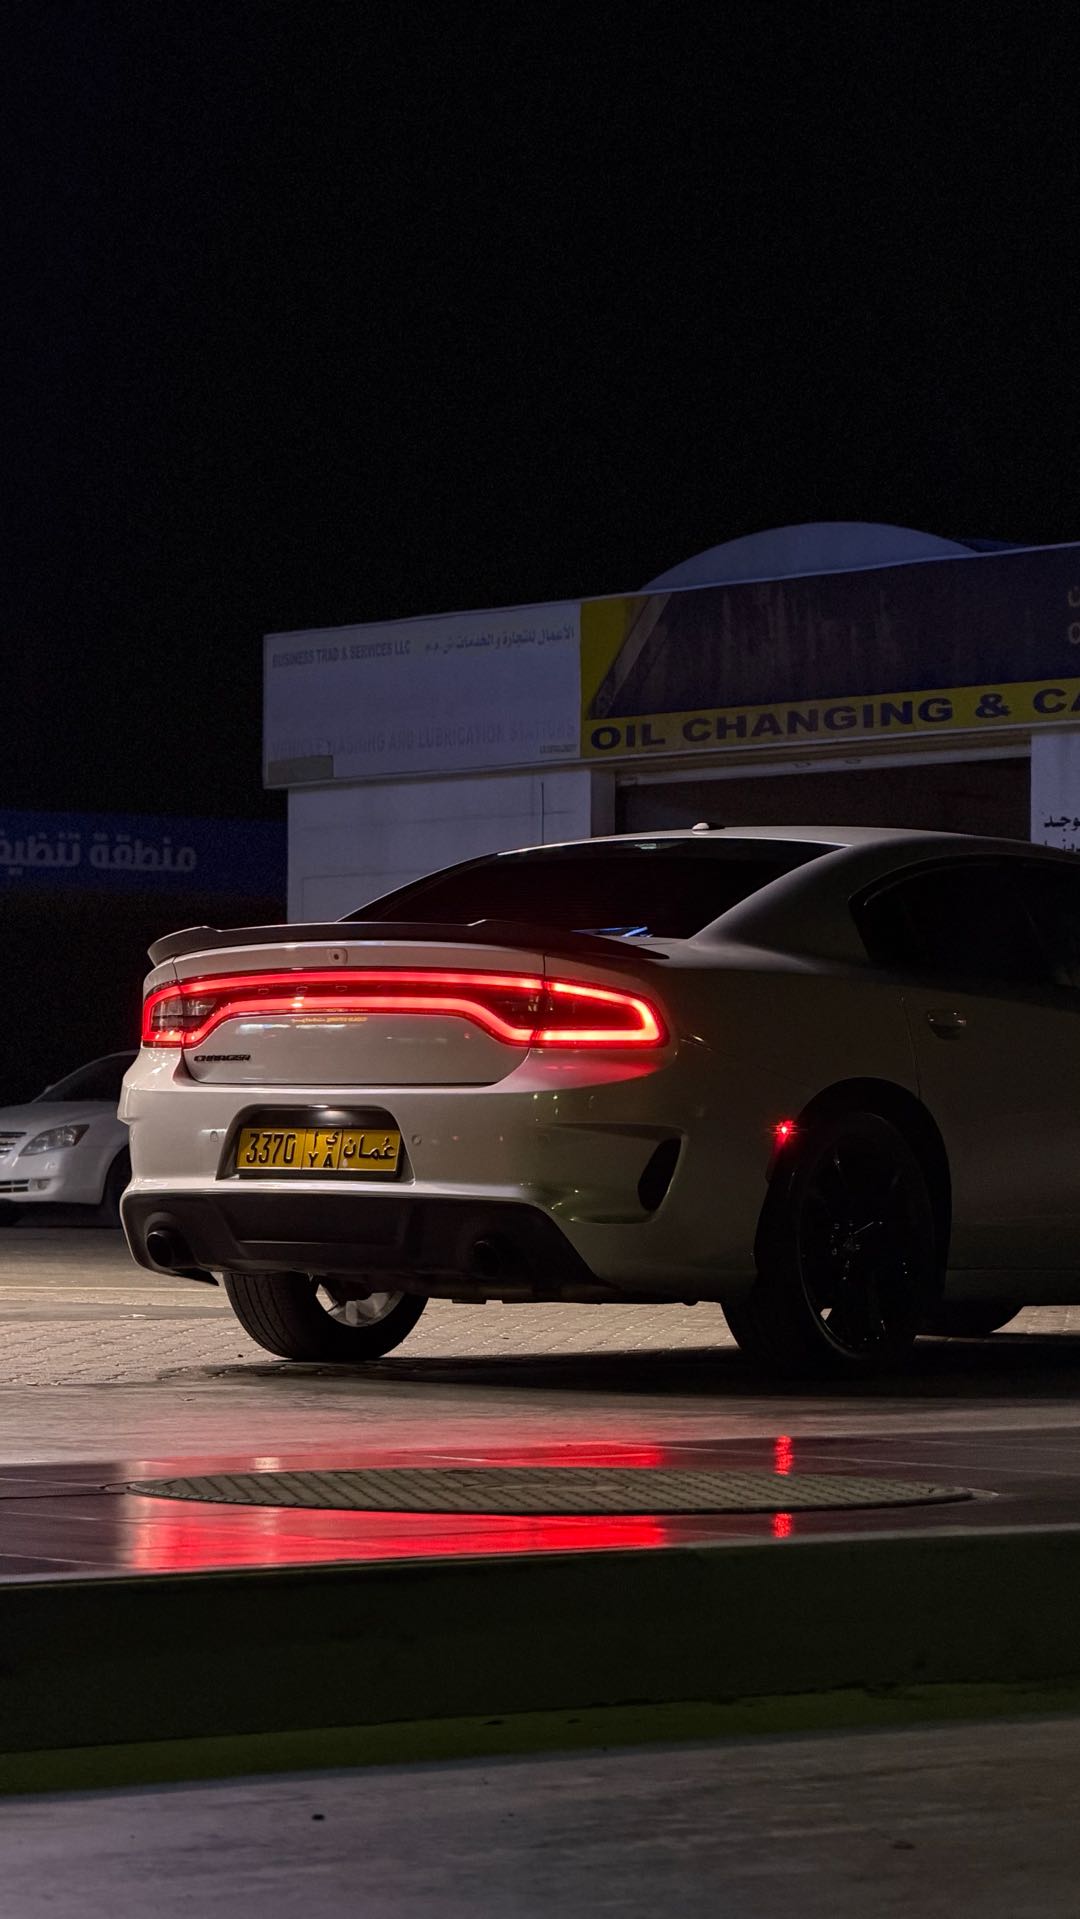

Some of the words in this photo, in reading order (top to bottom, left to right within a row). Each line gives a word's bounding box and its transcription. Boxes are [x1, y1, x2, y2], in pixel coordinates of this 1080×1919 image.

[273, 650, 314, 668] BUSINESS
[350, 642, 392, 659] SERVICES
[395, 639, 411, 655] LLC
[590, 723, 667, 751] OIL
[682, 697, 953, 741] CHANGING
[975, 693, 1011, 718] &
[1033, 688, 1080, 714] C
[88, 831, 198, 872] منطقة
[194, 1054, 251, 1062] CHARGER
[246, 1132, 296, 1164] 3370
